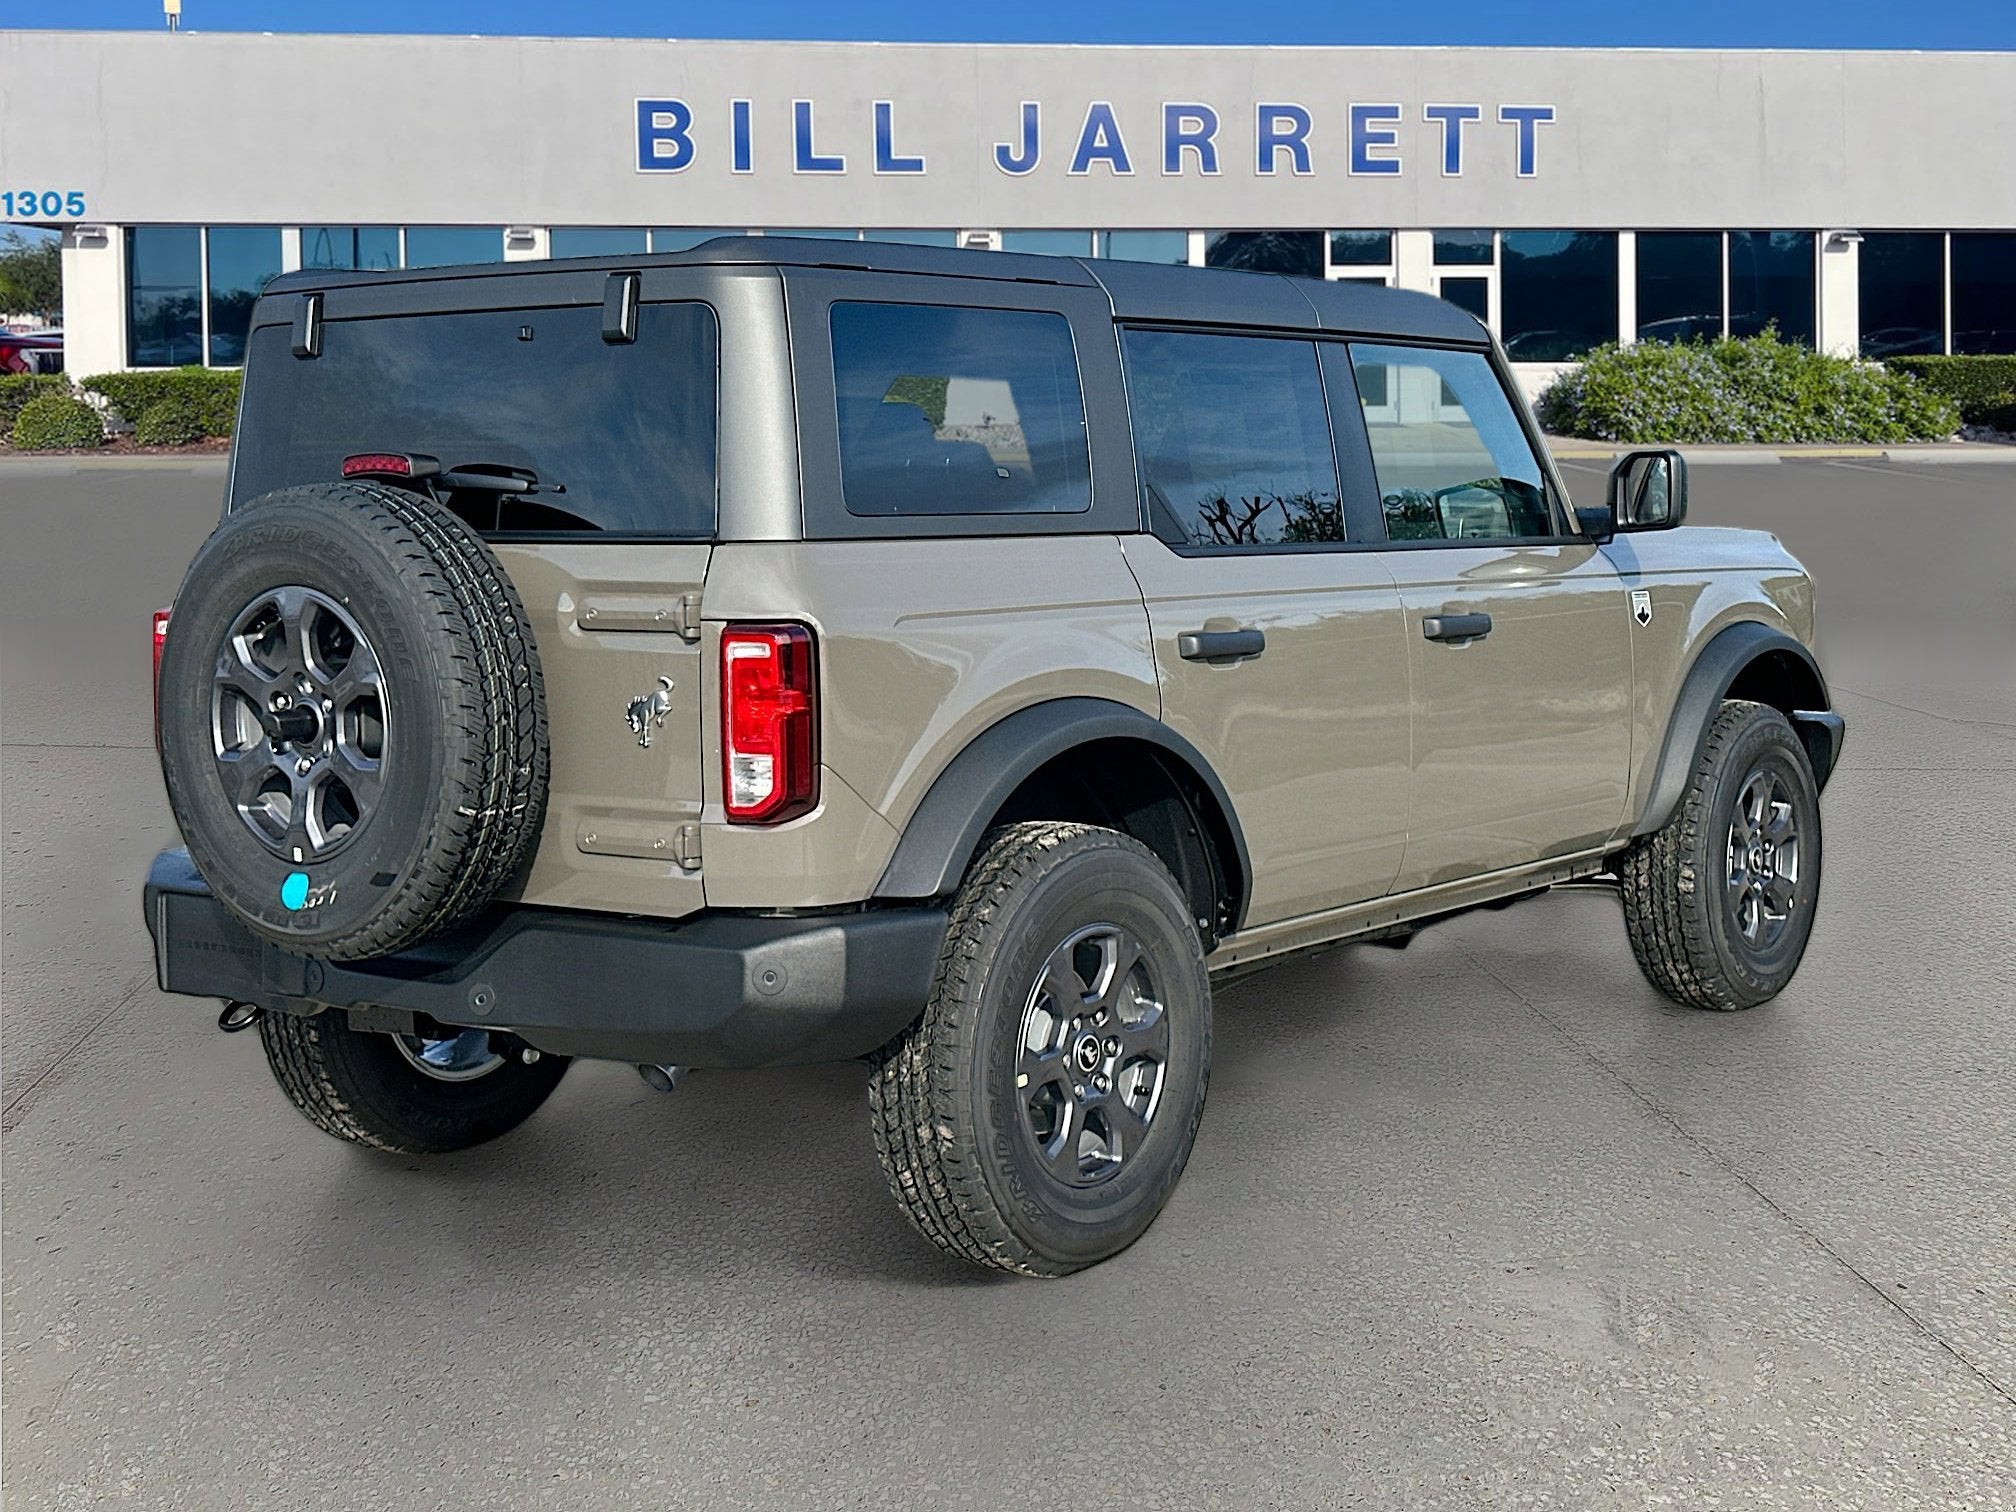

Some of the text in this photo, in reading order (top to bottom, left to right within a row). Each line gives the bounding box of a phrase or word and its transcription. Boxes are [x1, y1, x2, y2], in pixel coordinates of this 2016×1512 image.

[635, 97, 1556, 179] BILL JARRETT
[1, 191, 86, 217] 1305
[221, 522, 418, 683] BRIDGESTONE
[986, 921, 1047, 1223] BRIDGESTONE
